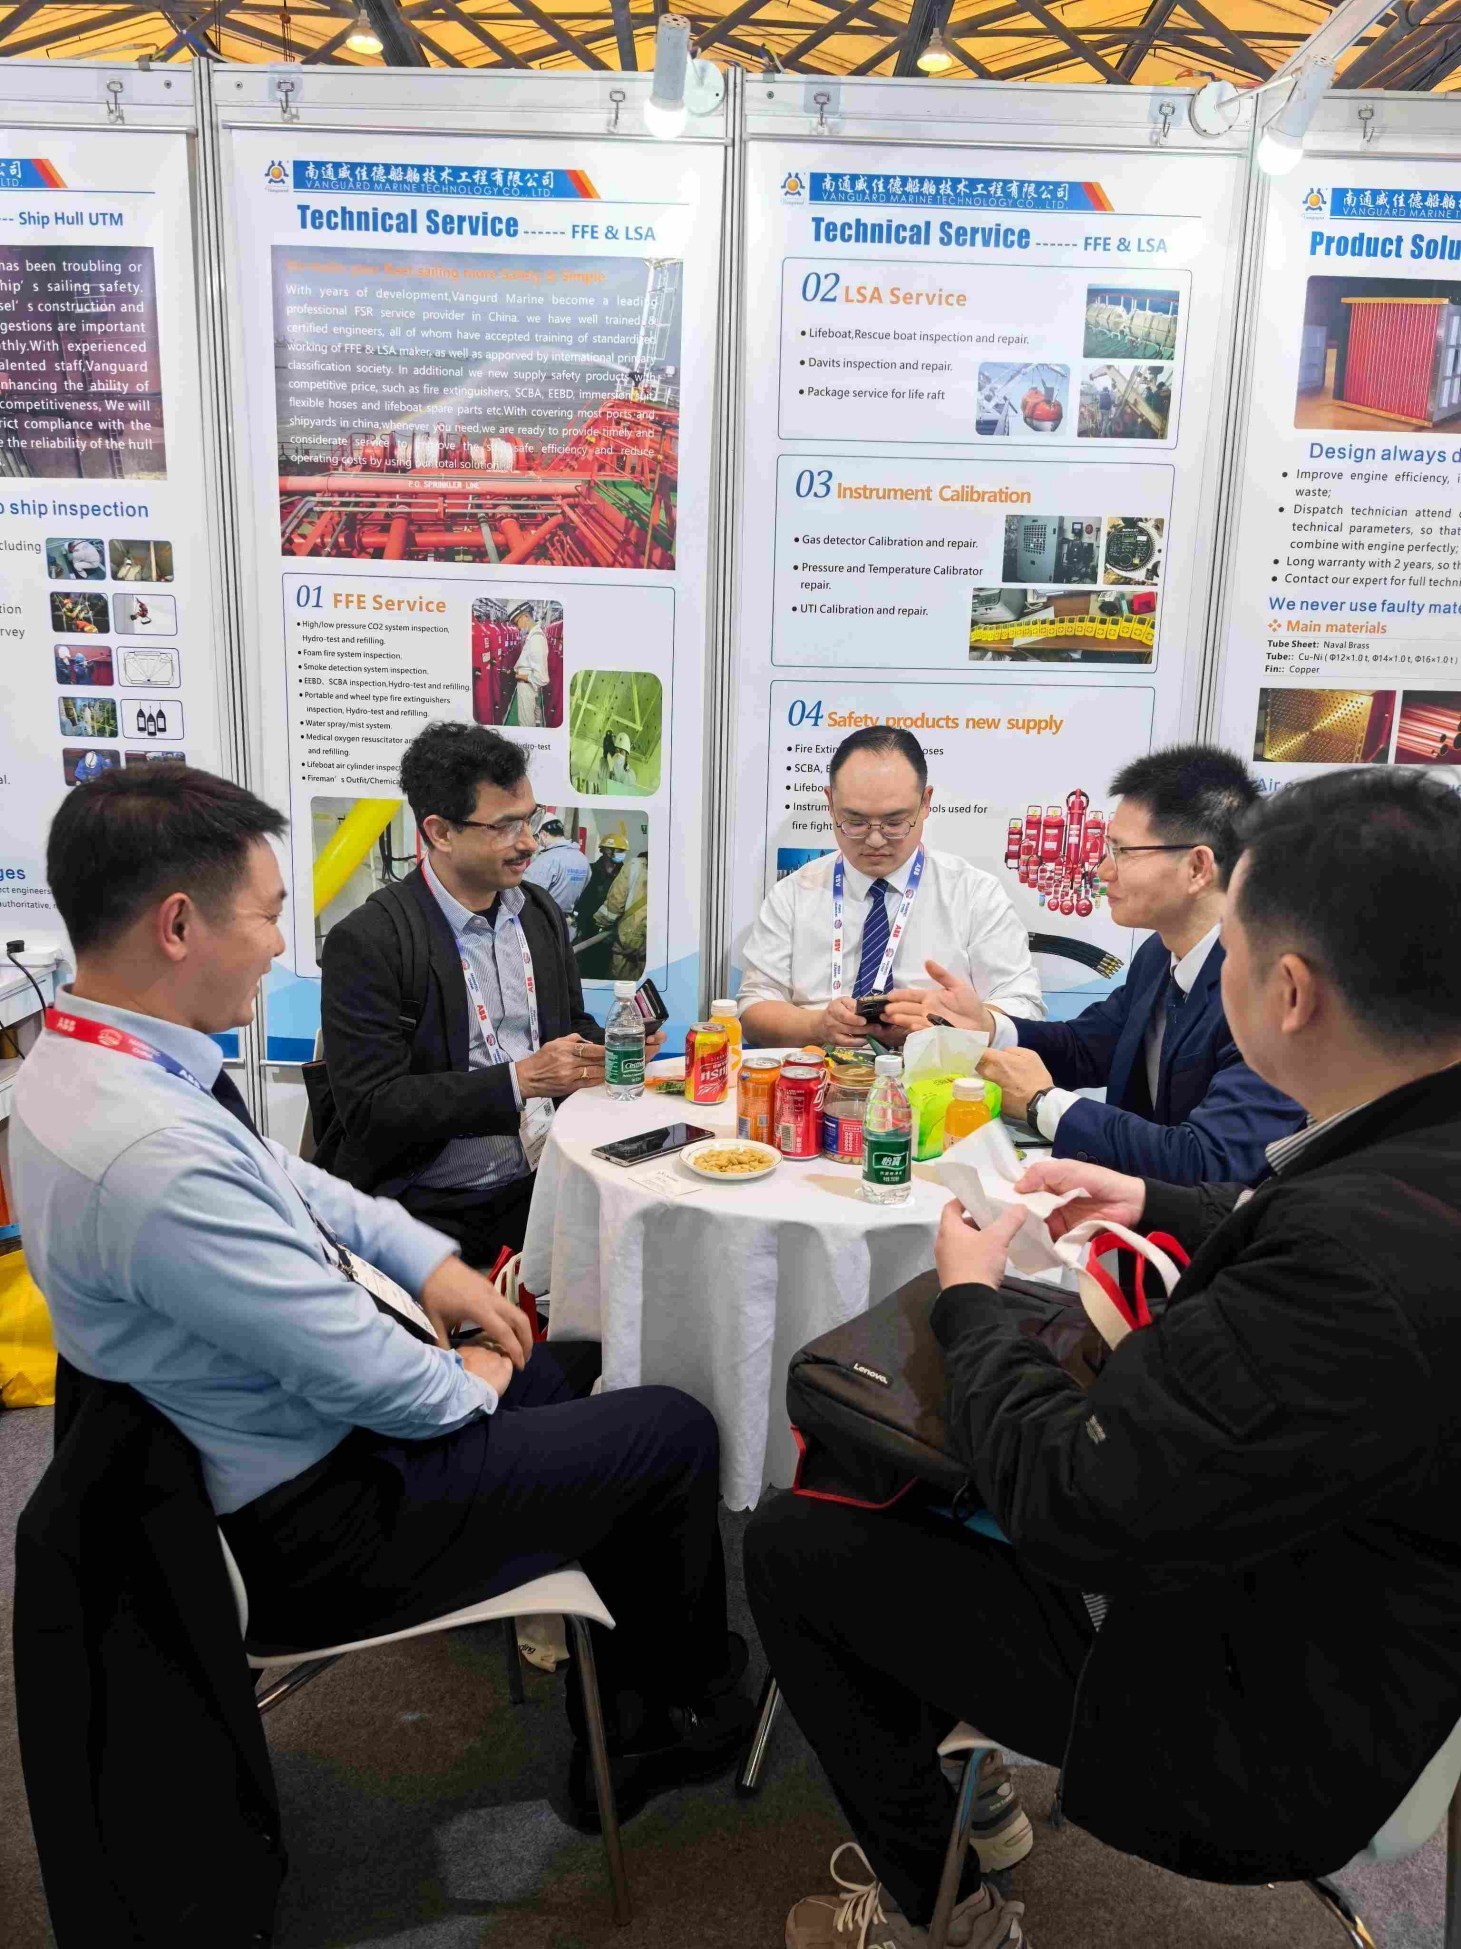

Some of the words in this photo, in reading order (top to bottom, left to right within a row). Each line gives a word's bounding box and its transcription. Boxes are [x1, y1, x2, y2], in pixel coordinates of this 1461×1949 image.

[305, 162, 554, 189] 南通威佳德船舶技术工程有限公司
[306, 180, 370, 191] VANGUARD
[374, 182, 417, 192] MARINE
[421, 184, 498, 196] TECHNOLOGY
[532, 188, 554, 198] LTD.
[821, 174, 1069, 201] 南通威佳德船舶技术工程有限公司
[822, 192, 886, 202] VANGUARD
[890, 194, 932, 204] MARINE
[937, 195, 1012, 207] TECHNOLOGY
[1046, 200, 1069, 209] LTD.
[1343, 189, 1461, 210] 南通威佳德船舶
[19, 211, 50, 229] Ship
[54, 212, 84, 225] Hull
[89, 212, 124, 226] UTM
[1343, 207, 1405, 217] VANGUARD
[1409, 209, 1451, 218] MARINE
[297, 205, 417, 234] Technical
[426, 209, 519, 237] Service
[572, 224, 599, 239] FFE
[605, 226, 619, 240] &
[625, 226, 656, 241] LSA
[812, 217, 931, 245] Technical
[939, 221, 1030, 249] Service
[1084, 236, 1111, 252] FFE
[1117, 237, 1131, 252] &
[1137, 237, 1167, 253] LSA
[1310, 231, 1403, 258] Product
[26, 260, 56, 273] been
[62, 261, 122, 275] troubling
[128, 263, 143, 273] or
[47, 280, 90, 295] sailing
[100, 281, 144, 295] safety.
[286, 285, 312, 296] With
[320, 286, 349, 298] years
[356, 287, 369, 298] of
[506, 294, 544, 304] Marine
[552, 295, 595, 305] become
[802, 272, 840, 302] 02
[844, 285, 883, 304] LSA
[889, 287, 967, 307] Service
[38, 301, 116, 313] construction
[121, 302, 144, 313] and
[286, 304, 347, 317] professional
[354, 307, 373, 316] FSR
[380, 308, 416, 319] service
[423, 310, 465, 322] provider
[472, 311, 481, 322] in
[526, 314, 541, 323] we
[548, 313, 572, 324] have
[578, 314, 598, 324] well
[605, 316, 640, 325] trained
[57, 323, 77, 332] are
[82, 320, 146, 334] important
[893, 330, 917, 341] boat
[919, 330, 973, 344] inspection
[975, 333, 995, 344] and
[997, 334, 1030, 346] repair.
[68, 341, 147, 354] experienced
[809, 357, 841, 368] Davits
[843, 358, 897, 372] inspection
[899, 360, 919, 371] and
[921, 361, 953, 373] repair.
[64, 379, 84, 391] the
[90, 380, 129, 394] ability
[136, 380, 150, 392] of
[807, 387, 850, 400] Package
[852, 388, 889, 399] service
[891, 388, 906, 399] for
[908, 389, 925, 400] life
[927, 389, 946, 400] raft
[105, 400, 125, 411] We
[128, 400, 151, 411] will
[24, 419, 93, 431] compliance
[98, 419, 125, 430] with
[130, 420, 152, 431] the
[7, 437, 27, 448] the
[31, 437, 86, 452] reliability
[90, 438, 102, 449] of
[105, 438, 126, 450] the
[129, 438, 153, 450] hull
[1310, 442, 1376, 463] Design
[1381, 445, 1447, 465] always
[1296, 469, 1343, 481] Improve
[1350, 471, 1388, 483] engine
[1394, 471, 1450, 485] efficiency,
[795, 469, 833, 499] 03
[837, 483, 932, 501] Instrument
[938, 484, 1031, 504] Calibration
[10, 499, 48, 519] ship
[52, 501, 149, 519] inspection
[1294, 504, 1343, 517] Dispatch
[1351, 506, 1408, 517] technician
[1415, 508, 1451, 518] attend
[802, 534, 821, 545] Gas
[823, 534, 866, 546] detector
[868, 536, 924, 548] Calibration
[926, 537, 945, 548] and
[947, 538, 978, 550] repair.
[1290, 540, 1339, 549] combine
[1341, 540, 1365, 550] with
[1367, 542, 1405, 554] engine
[802, 562, 844, 573] Pressure
[846, 563, 866, 574] and
[868, 564, 931, 577] Temperature
[933, 565, 984, 576] Calibrator
[800, 580, 832, 593] repair.
[1285, 573, 1329, 584] Contact
[1331, 575, 1350, 584] our
[1352, 576, 1388, 587] expert
[1390, 576, 1406, 586] for
[1408, 576, 1426, 587] full
[296, 585, 323, 608] 01
[333, 593, 366, 609] FFE
[372, 596, 446, 613] Service
[1269, 597, 1296, 611] We
[1300, 599, 1345, 611] never
[1350, 600, 1377, 612] use
[1381, 600, 1426, 616] faulty
[800, 604, 817, 614] UTI
[820, 604, 874, 616] Calibration
[876, 605, 895, 616] and
[897, 606, 929, 618] repair.
[303, 621, 334, 630] High/low
[336, 622, 366, 631] pressure
[385, 624, 409, 632] system
[1287, 620, 1321, 633] Main
[1326, 621, 1387, 634] materials
[303, 635, 340, 643] Hydro-test
[356, 637, 386, 645] refilling.
[788, 699, 823, 728] 04
[827, 711, 880, 728] Safety
[886, 713, 959, 730] products
[965, 715, 1001, 729] new
[1006, 714, 1063, 735] supply
[477, 1004, 487, 1021] ABB
[853, 1363, 888, 1384] Lenovo
